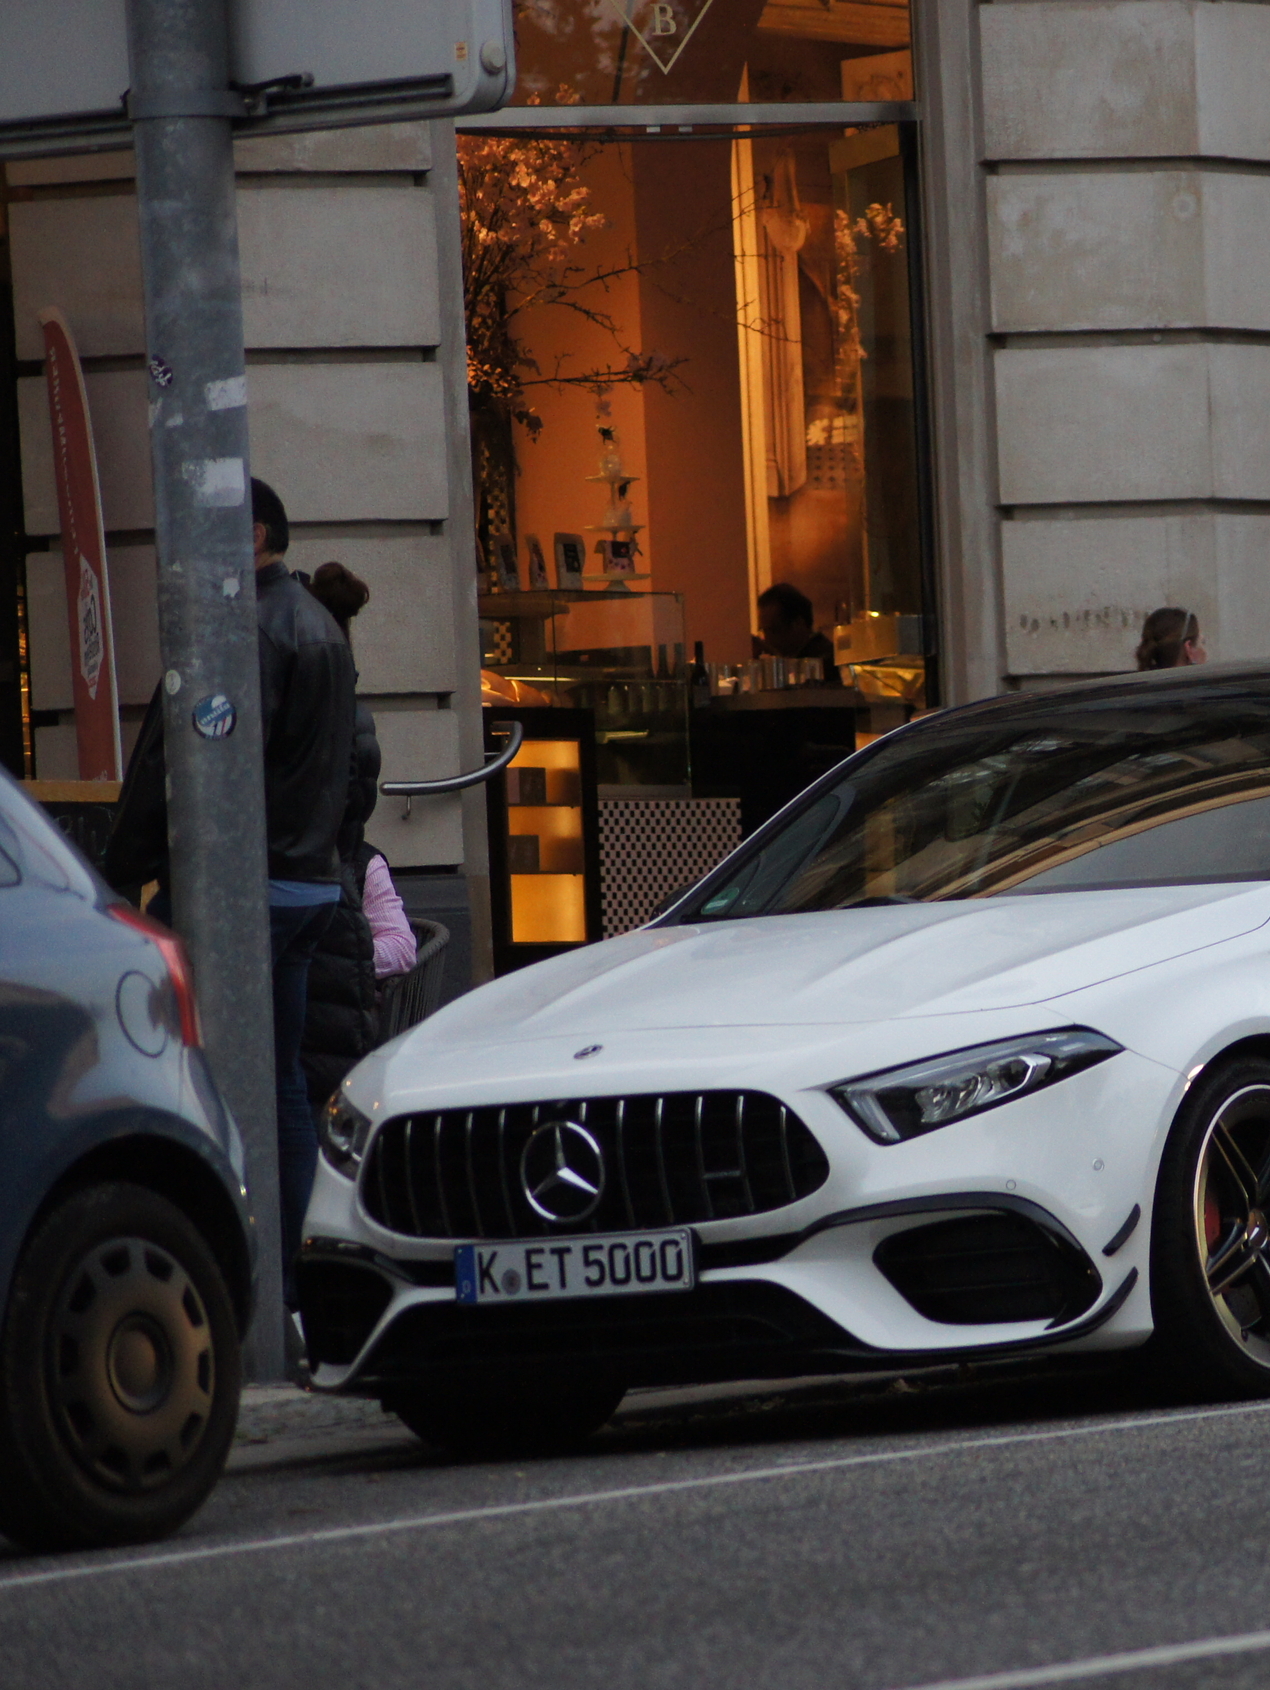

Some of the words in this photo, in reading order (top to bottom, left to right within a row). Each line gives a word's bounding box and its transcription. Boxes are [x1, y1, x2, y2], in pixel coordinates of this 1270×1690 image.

[649, 3, 677, 36] B
[478, 1251, 500, 1294] K
[525, 1247, 572, 1290] ET
[583, 1238, 684, 1287] 5000
